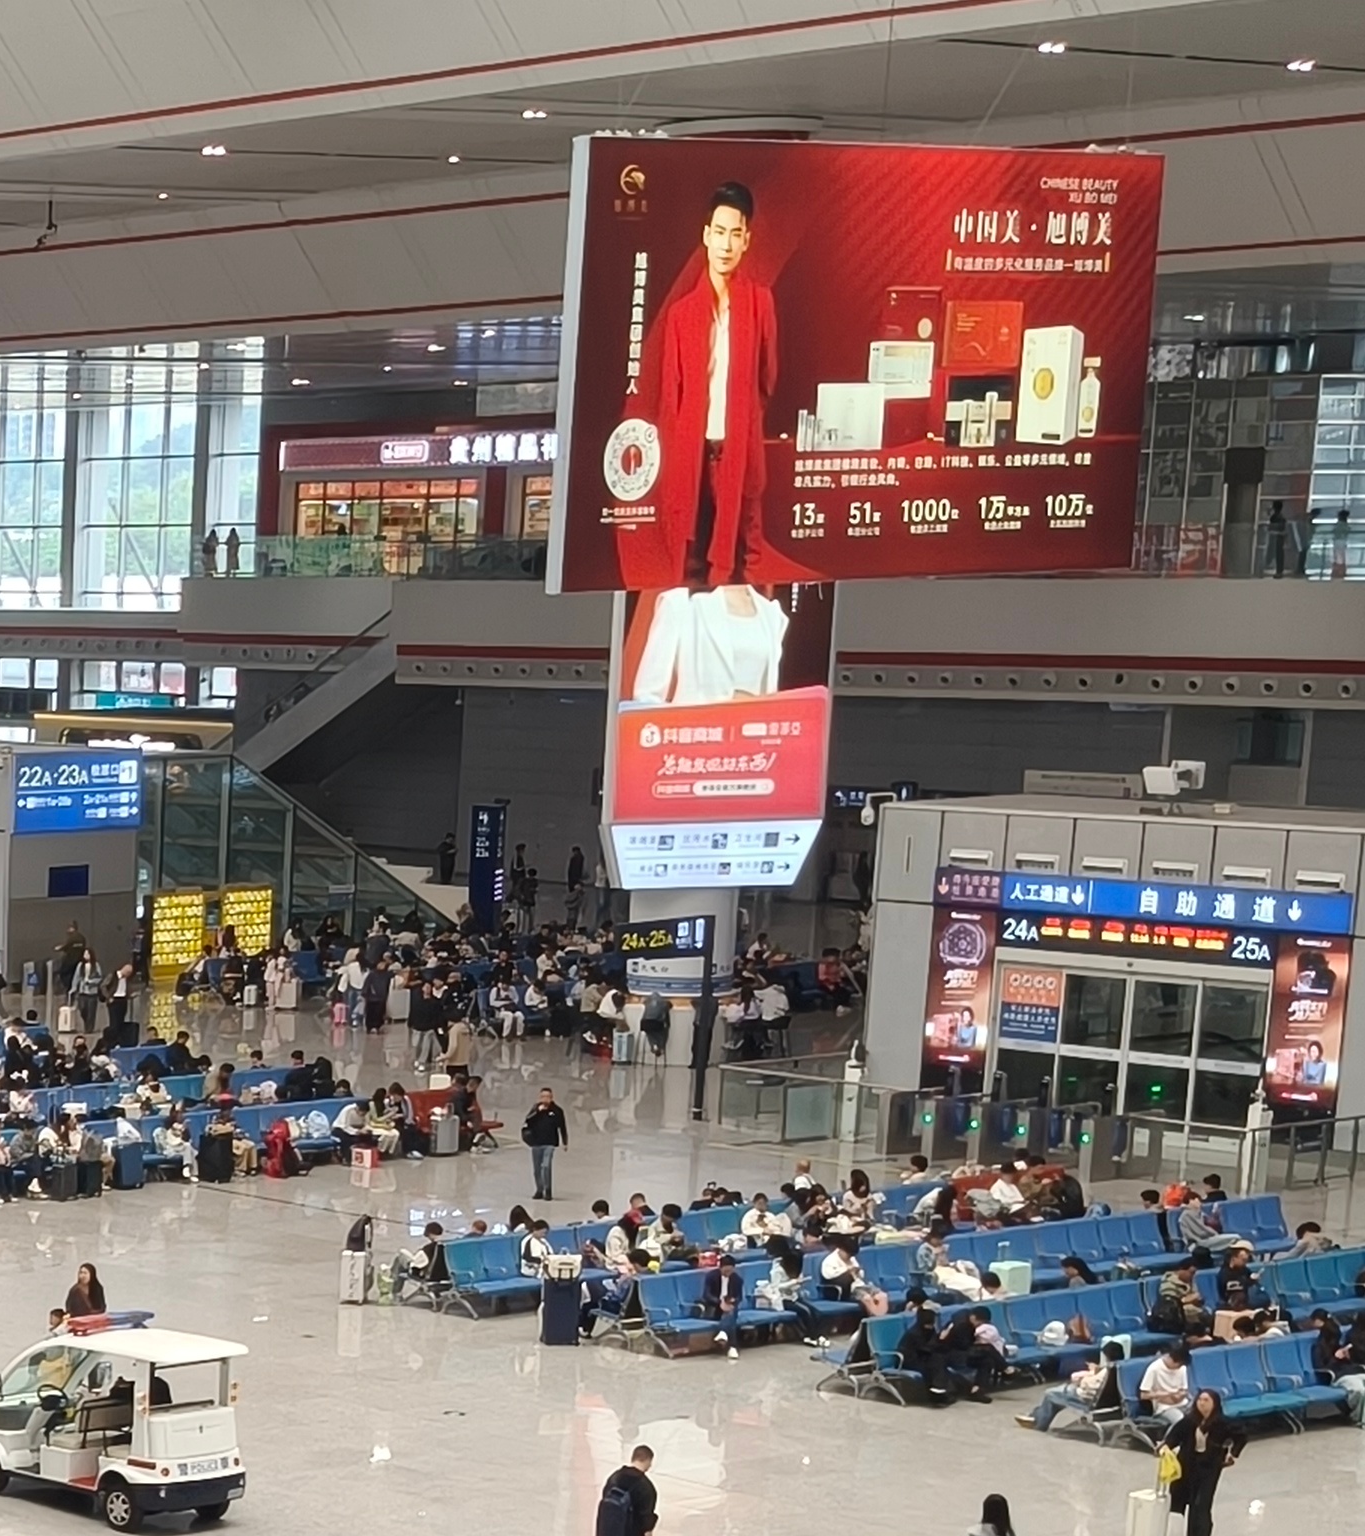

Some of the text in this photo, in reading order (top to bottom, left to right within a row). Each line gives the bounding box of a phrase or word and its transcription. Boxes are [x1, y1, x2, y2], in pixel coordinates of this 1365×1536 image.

[18, 764, 89, 787] 22A·23A
[1010, 882, 1069, 904] 人工通道
[1139, 888, 1277, 923] 自助通道
[1002, 917, 1040, 942] 24A
[1231, 935, 1271, 962] 25A
